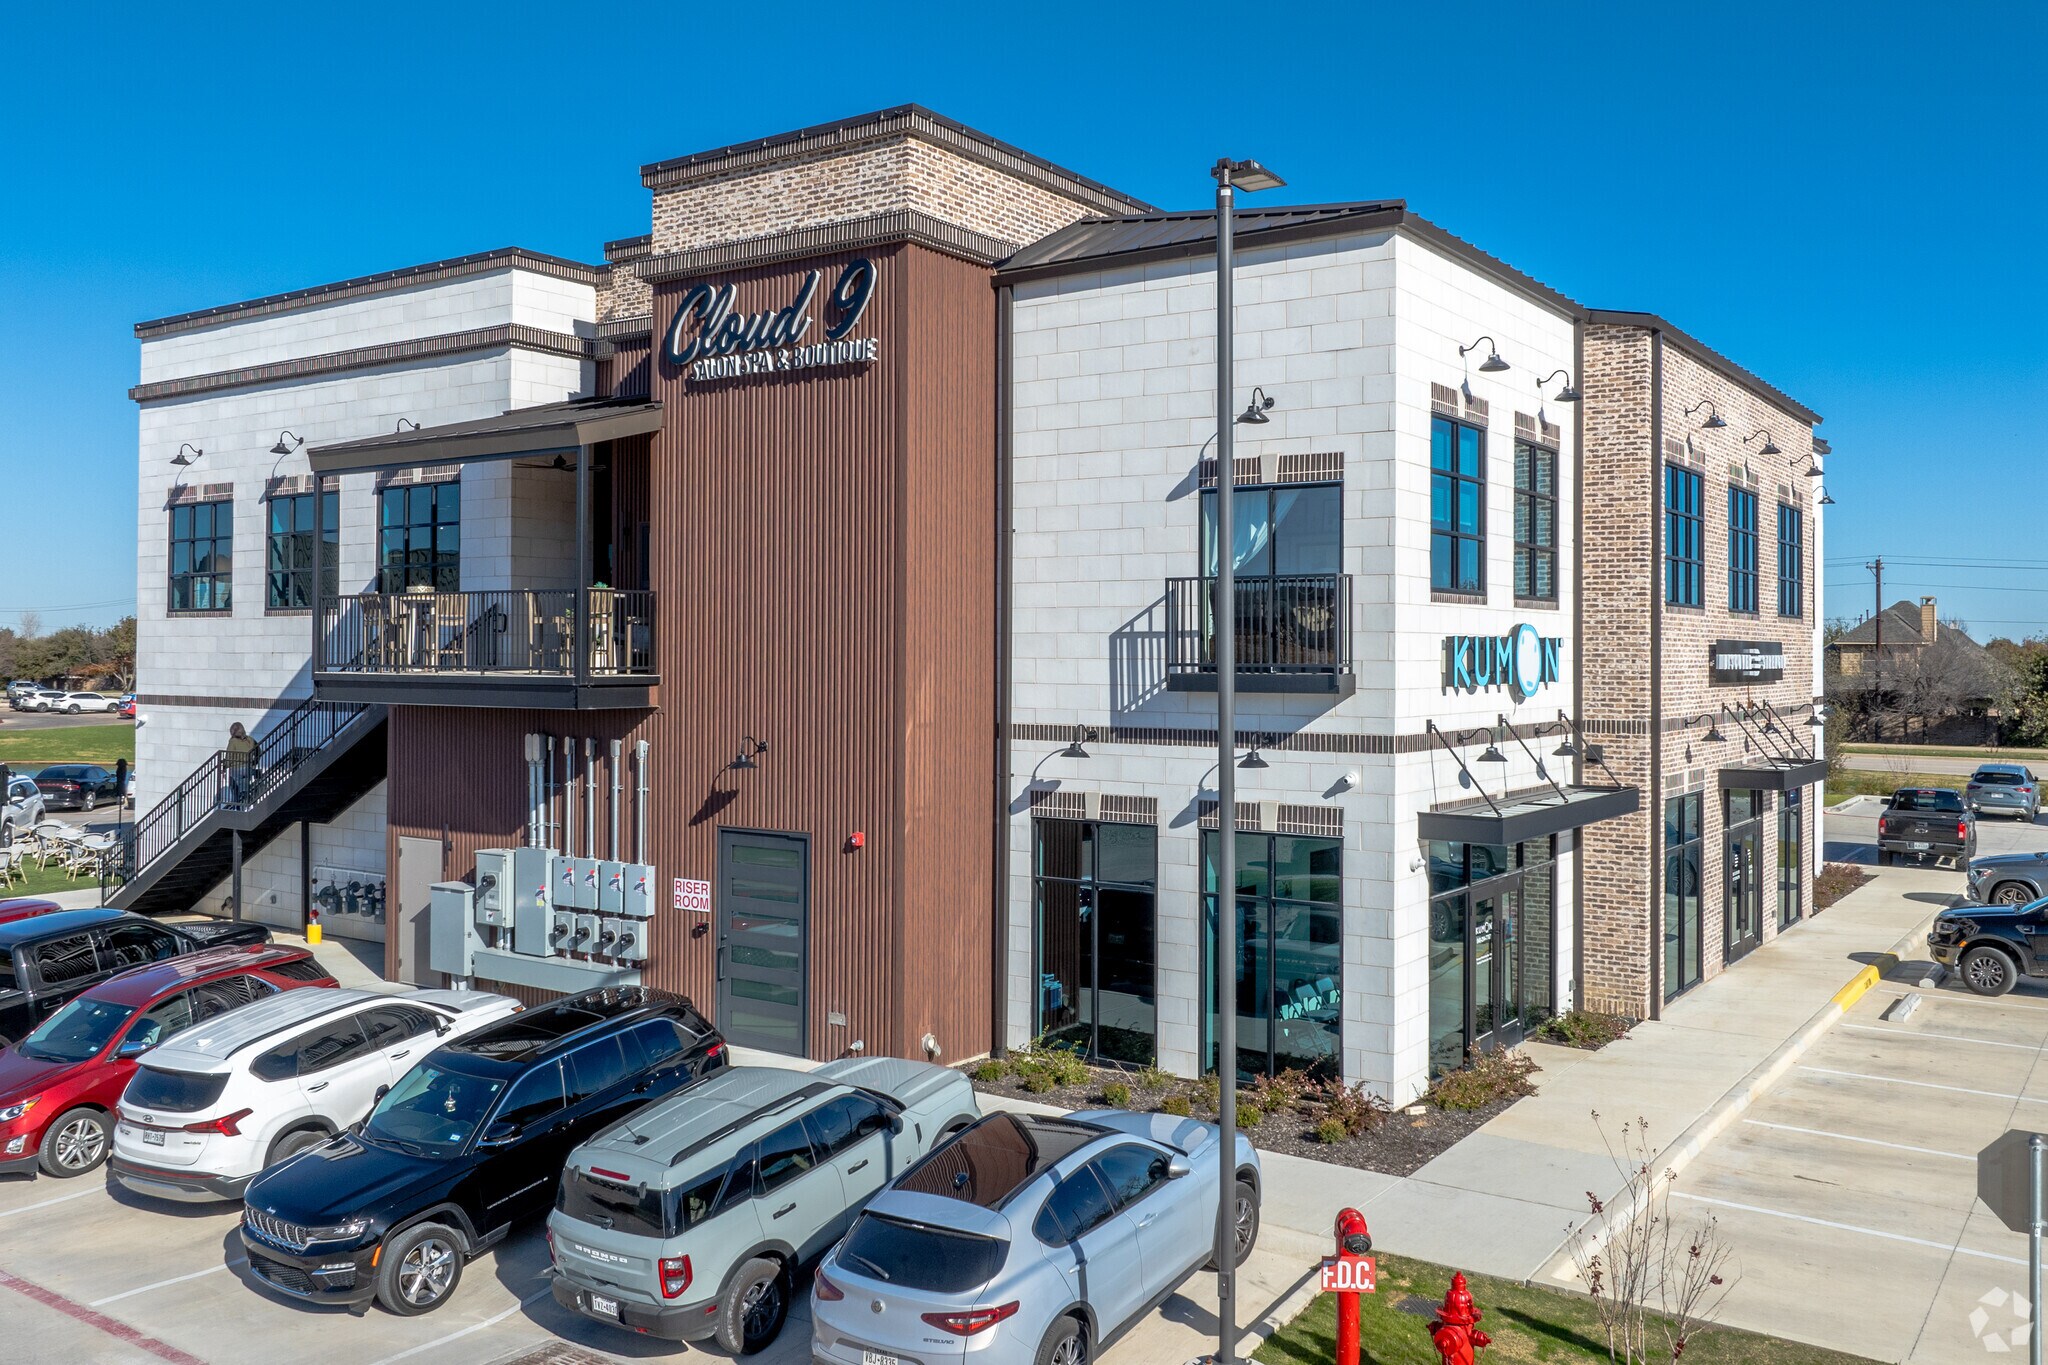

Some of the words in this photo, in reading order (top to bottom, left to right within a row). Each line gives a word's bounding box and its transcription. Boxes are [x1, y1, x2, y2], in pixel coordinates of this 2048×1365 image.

[666, 269, 822, 365] Cloud
[826, 257, 877, 340] 9
[691, 353, 740, 381] SALON
[741, 350, 775, 374] SPA
[777, 348, 791, 371] &
[794, 337, 878, 369] BOUTIQUE
[1452, 623, 1560, 698] KUMON
[675, 880, 709, 895] RISER
[674, 894, 709, 910] ROOM
[574, 1244, 628, 1264] BRONCO
[1322, 1260, 1375, 1289] F.D.C.
[922, 1337, 955, 1345] STELVIO
